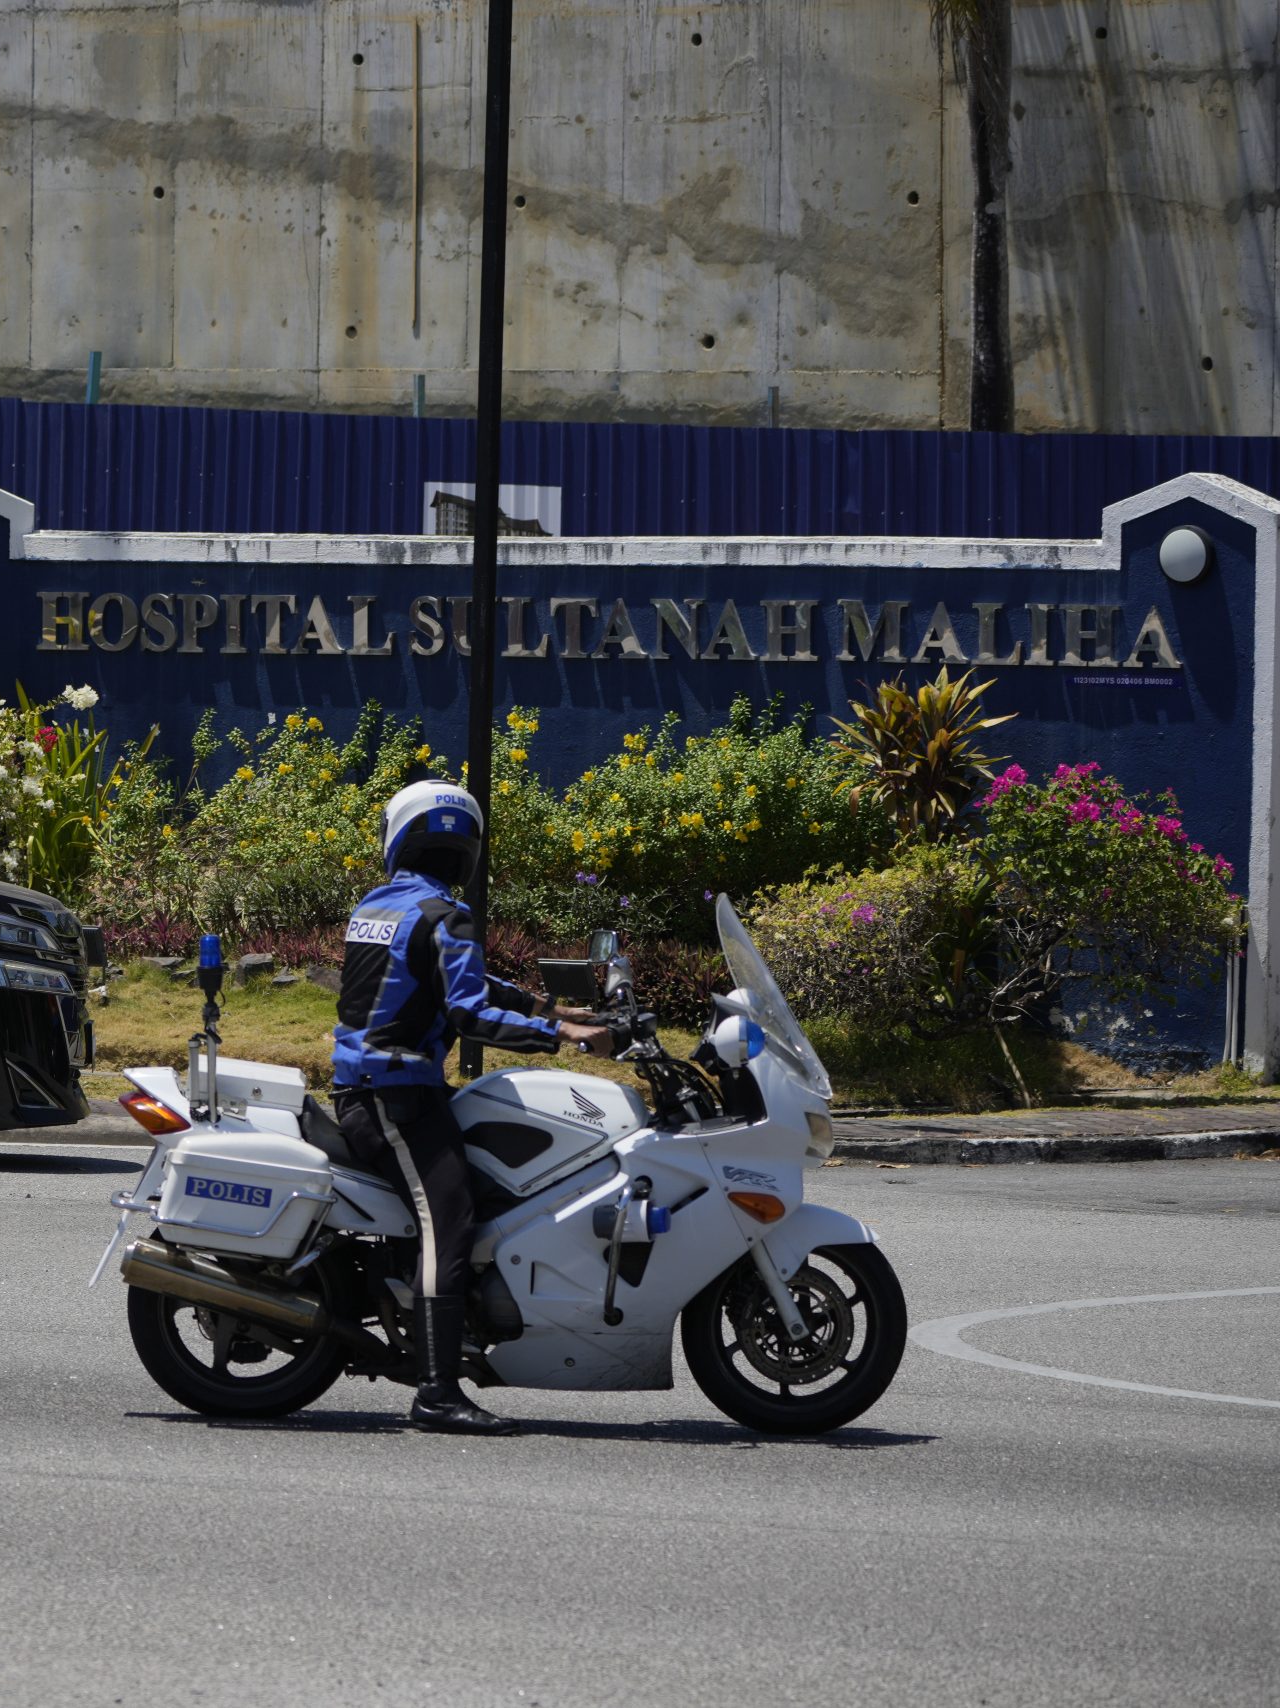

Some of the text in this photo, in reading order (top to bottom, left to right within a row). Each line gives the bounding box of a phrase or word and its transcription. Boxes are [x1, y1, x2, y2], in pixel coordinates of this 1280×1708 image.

[35, 590, 393, 655] HOSPITAL
[835, 599, 1185, 669] MALIHA
[435, 794, 466, 807] POLIS
[348, 920, 393, 941] POLIS
[562, 1110, 604, 1128] HONDA
[191, 1178, 266, 1206] POLIS
